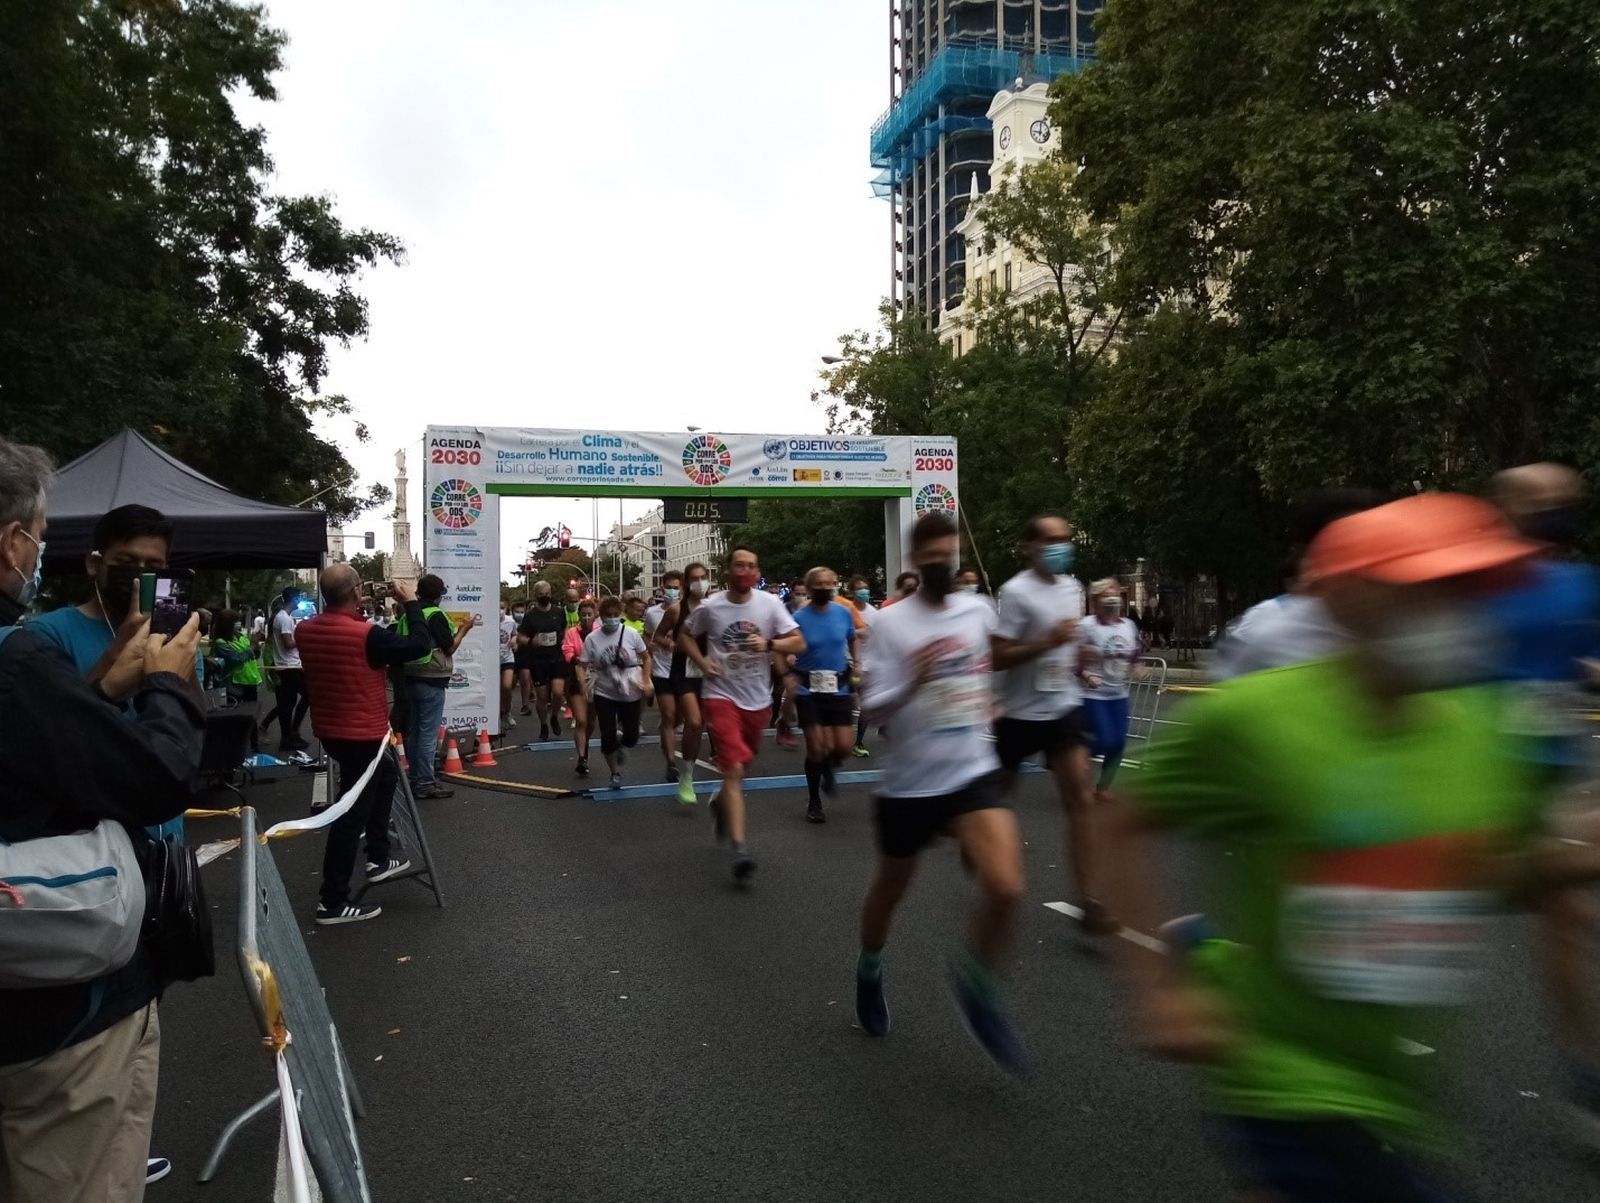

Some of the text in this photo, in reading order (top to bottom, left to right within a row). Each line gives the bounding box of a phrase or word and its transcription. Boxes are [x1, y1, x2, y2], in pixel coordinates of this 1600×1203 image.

[431, 438, 481, 449] AGENDA
[582, 434, 622, 448] Clima
[789, 439, 850, 451] OBJETIVOS
[431, 449, 481, 466] 2030
[497, 450, 546, 460] Desarrollo
[549, 447, 607, 461] Humano
[697, 450, 716, 458] CORRE
[914, 448, 954, 457] AGENDA
[528, 461, 560, 476] dejar
[565, 464, 573, 474] a
[577, 462, 615, 475] nadie
[619, 463, 663, 476] atrás!!
[700, 464, 714, 473] ODS
[915, 458, 954, 471] 2030
[446, 493, 466, 501] CORRE
[449, 507, 464, 516] ODS
[452, 716, 489, 725] MADRID
